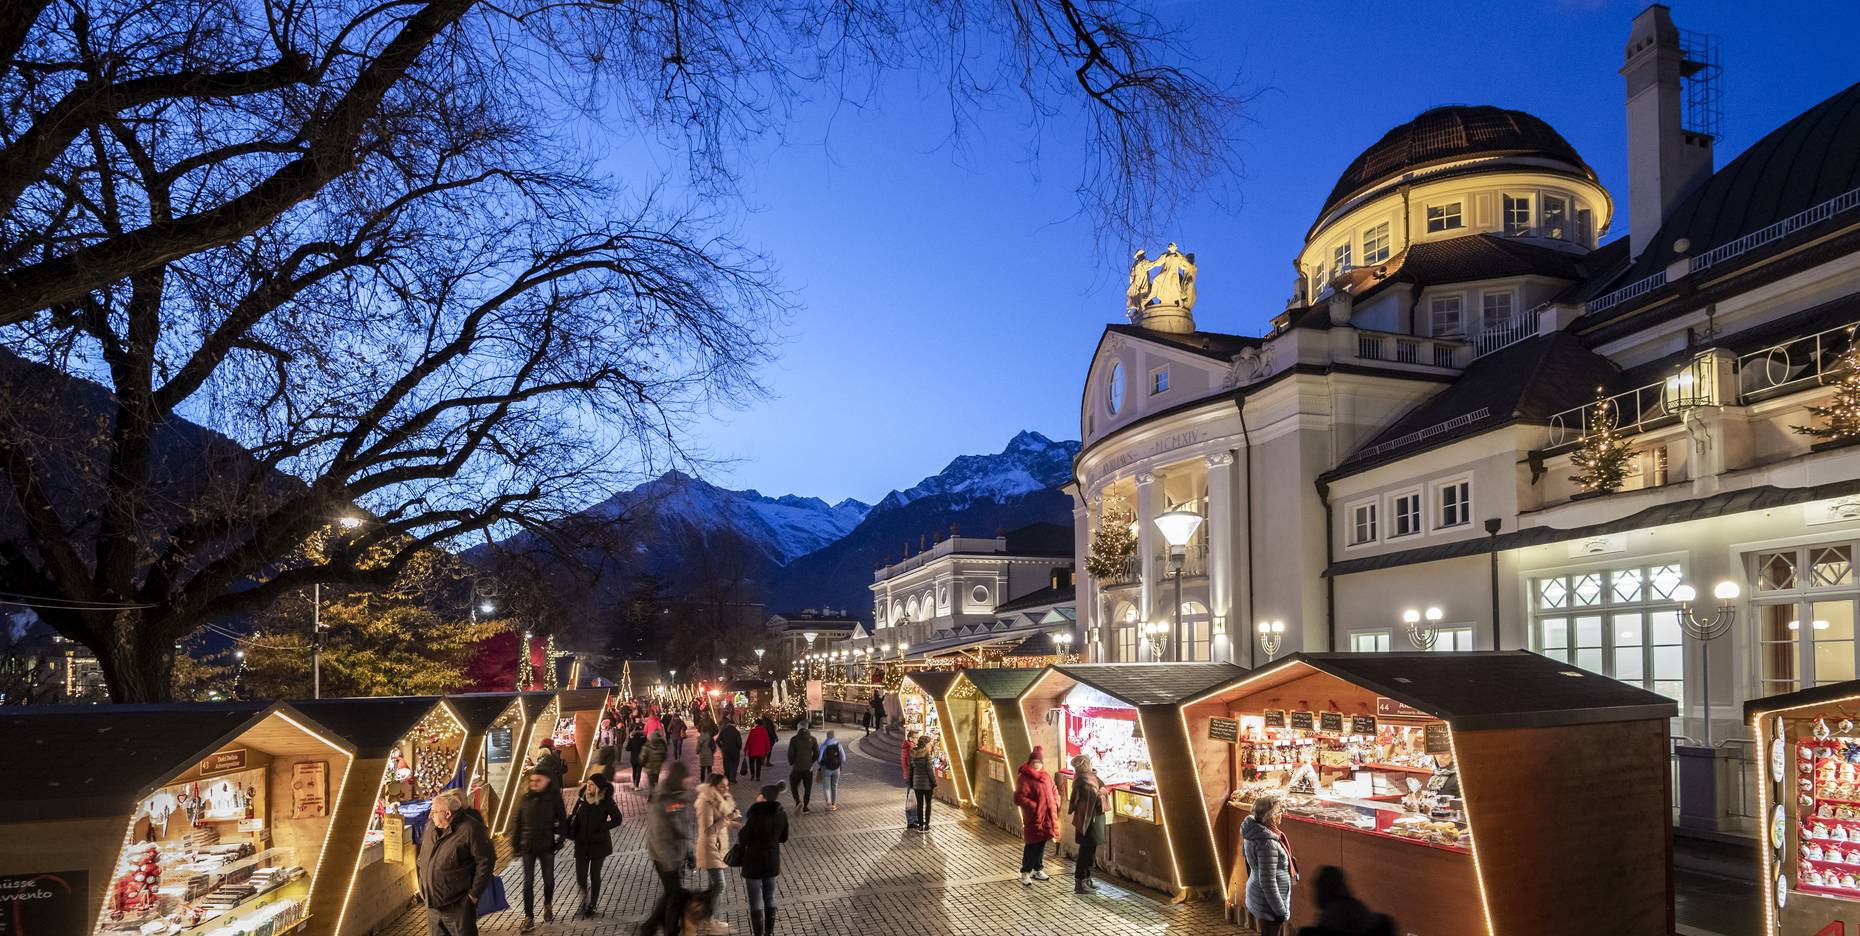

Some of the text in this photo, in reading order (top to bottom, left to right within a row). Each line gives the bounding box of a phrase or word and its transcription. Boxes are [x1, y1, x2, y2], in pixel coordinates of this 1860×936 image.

[1380, 703, 1390, 711] 44
[202, 761, 209, 769] 43
[0, 879, 36, 889] üsse
[0, 889, 53, 901] vvento
